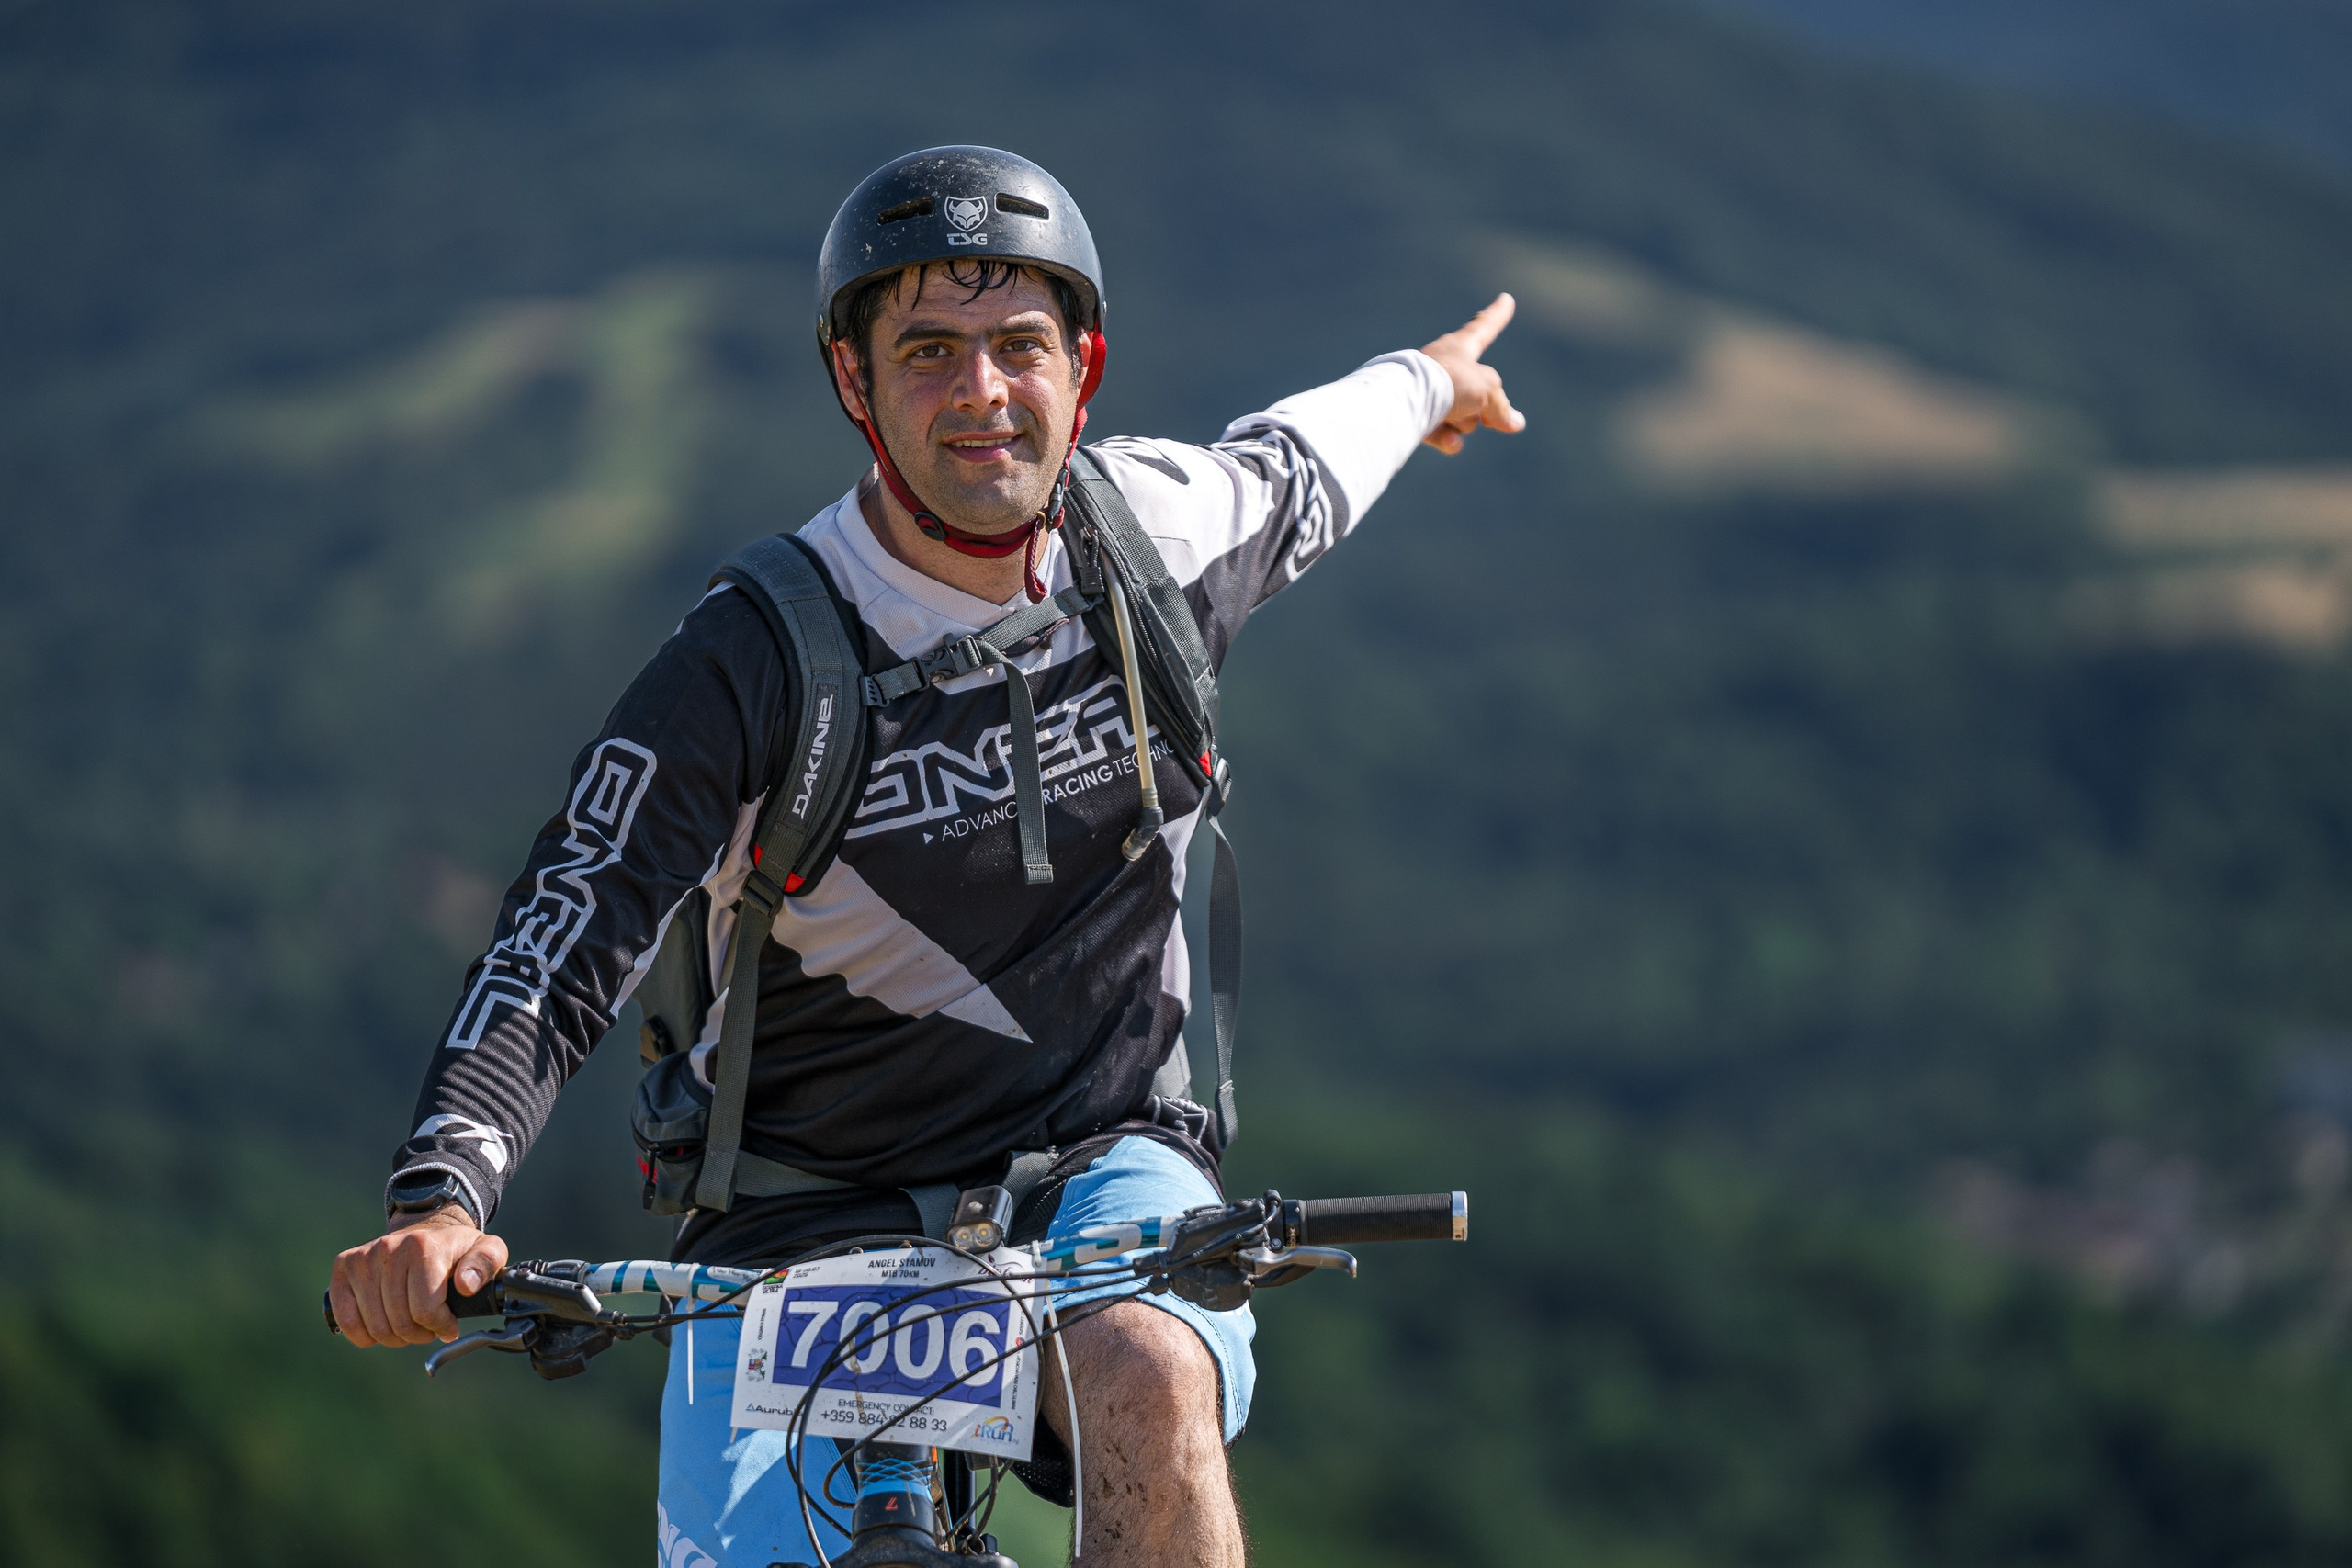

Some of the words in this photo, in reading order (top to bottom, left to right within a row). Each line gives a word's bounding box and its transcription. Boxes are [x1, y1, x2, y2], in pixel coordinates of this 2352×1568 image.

[946, 232, 988, 246] TSG
[792, 694, 833, 820] DAKINE
[844, 674, 1161, 840] ONEA
[1042, 764, 1114, 806] RACING
[868, 1258, 897, 1268] ANGEL
[899, 1258, 936, 1268] STAMOV
[881, 1269, 898, 1278] MTB
[787, 1301, 1001, 1387] 7006
[755, 1404, 804, 1416] Aurubs
[838, 1398, 891, 1411] EMERGENCY
[893, 1403, 935, 1416] CONACT:
[821, 1409, 854, 1423] +359
[858, 1412, 884, 1425] 884
[910, 1416, 927, 1429] 88
[931, 1418, 947, 1431] 33
[974, 1422, 1013, 1442] iRun
